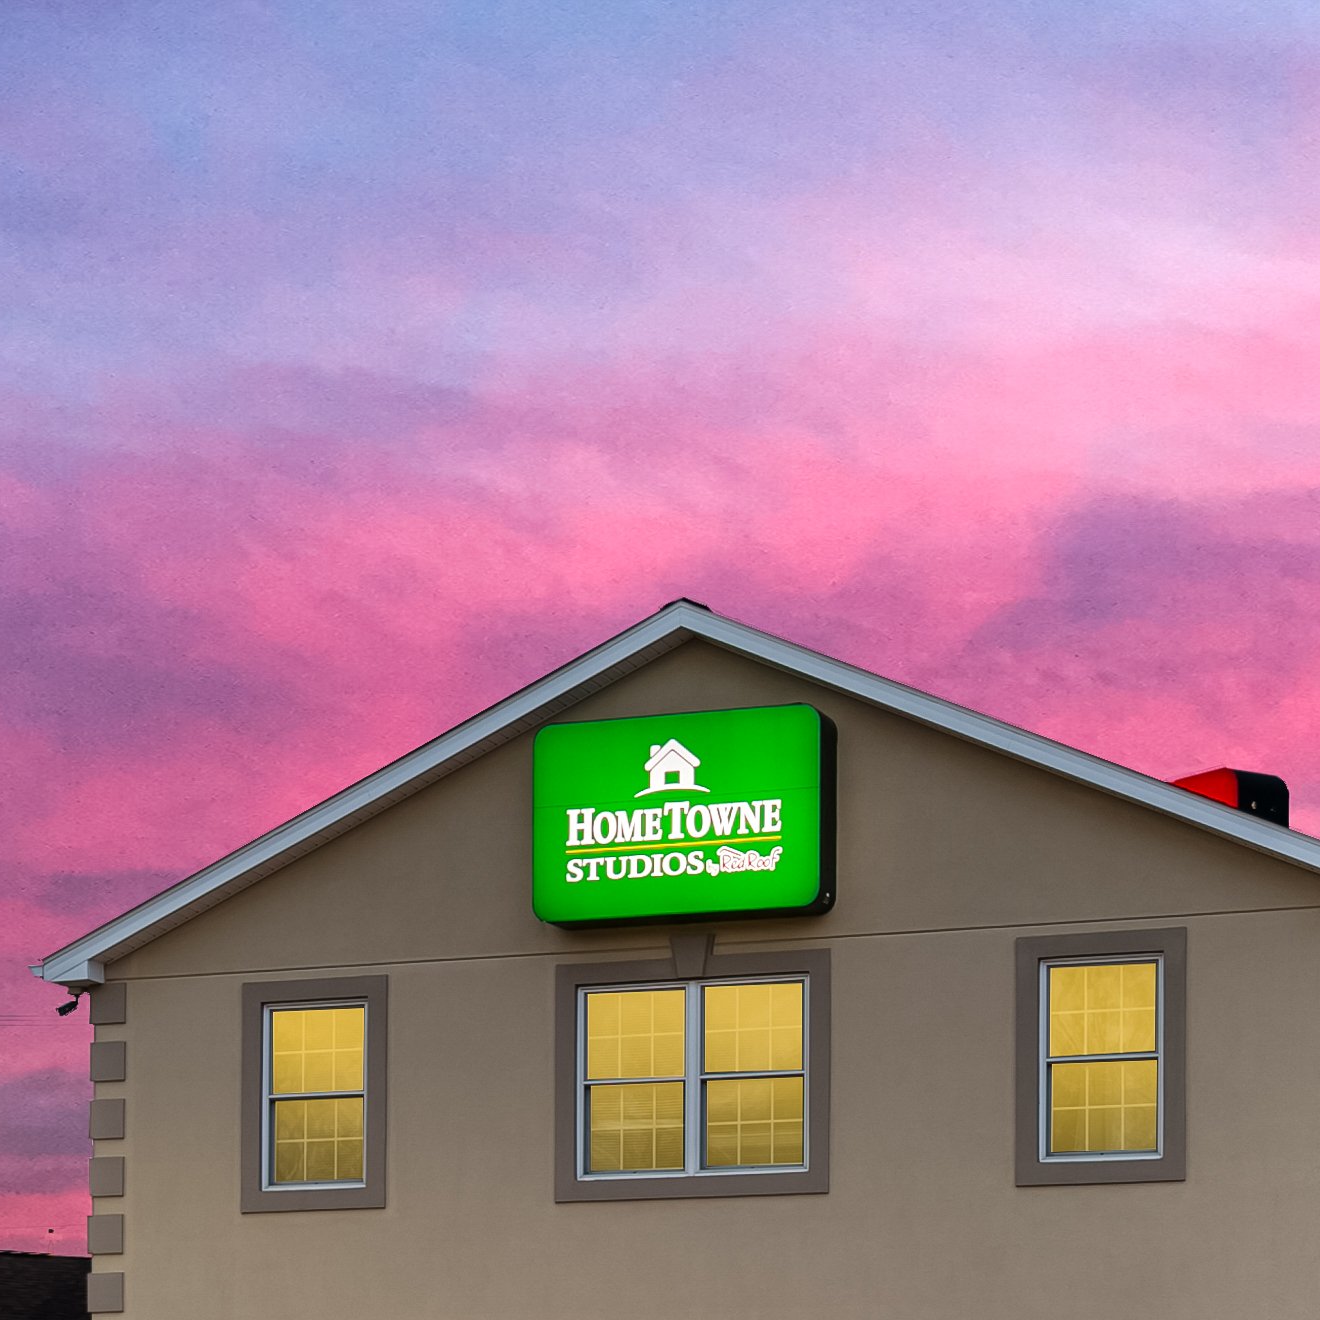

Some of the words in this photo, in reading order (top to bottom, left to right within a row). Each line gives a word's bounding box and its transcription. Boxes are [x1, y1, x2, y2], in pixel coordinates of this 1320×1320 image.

[566, 851, 704, 882] STUDIOS
[721, 852, 746, 872] Red
[747, 847, 782, 871] Roof
